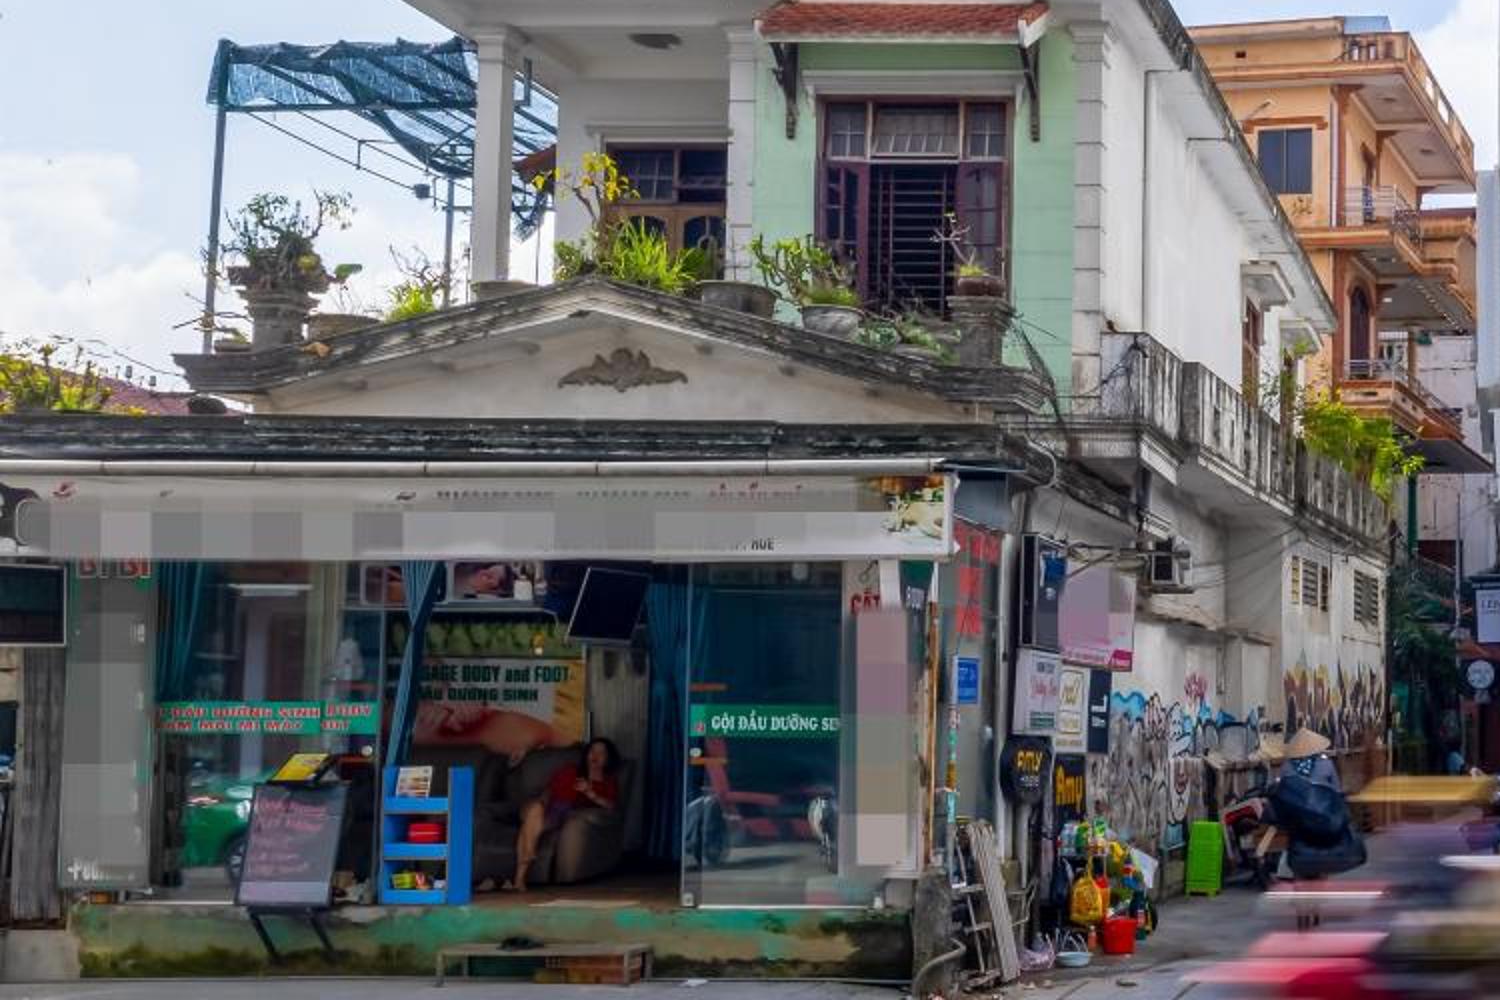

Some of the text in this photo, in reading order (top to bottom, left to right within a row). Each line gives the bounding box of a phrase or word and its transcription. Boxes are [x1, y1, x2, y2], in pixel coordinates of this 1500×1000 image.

[462, 665, 500, 683] BODY
[506, 666, 530, 683] and
[534, 666, 569, 683] FOOT
[503, 687, 538, 701] SINH
[711, 712, 735, 734] GỘI
[738, 709, 767, 731] ĐẦU
